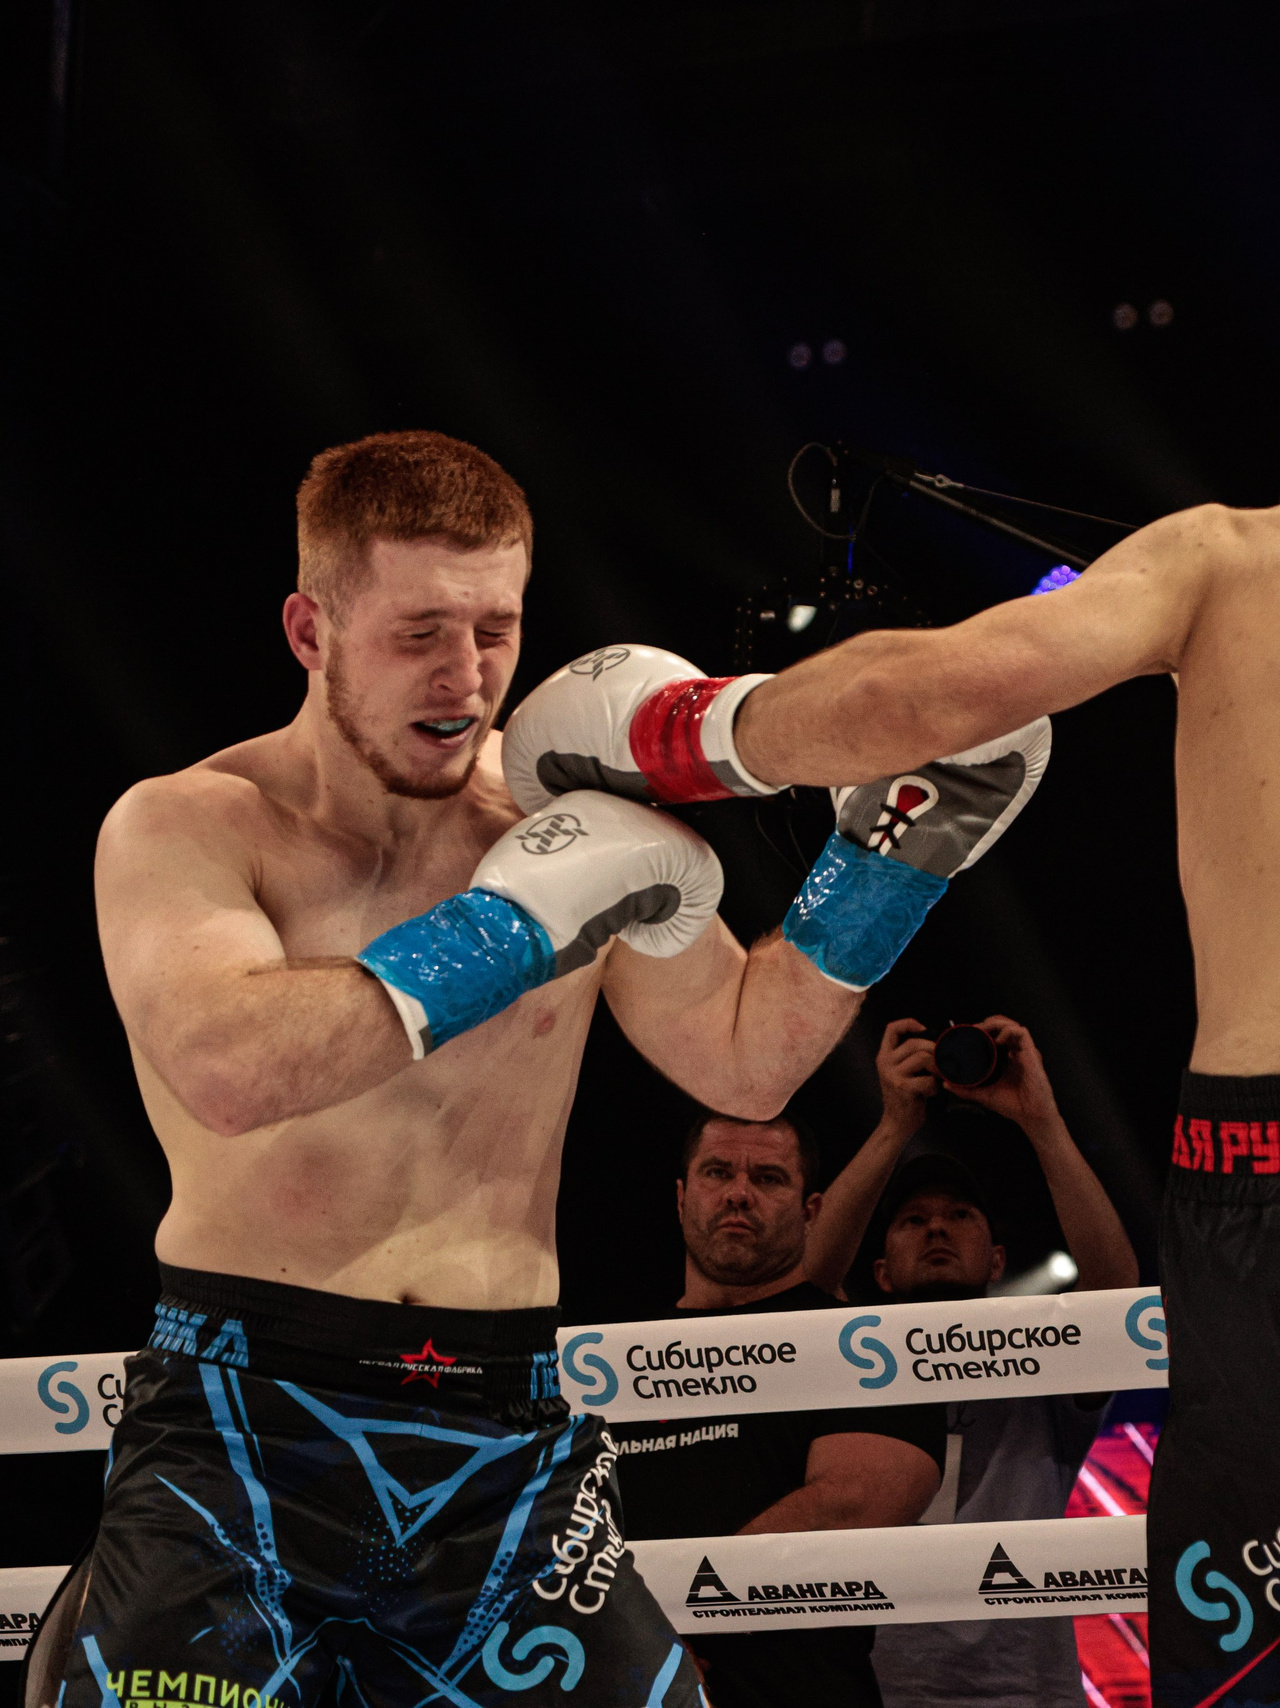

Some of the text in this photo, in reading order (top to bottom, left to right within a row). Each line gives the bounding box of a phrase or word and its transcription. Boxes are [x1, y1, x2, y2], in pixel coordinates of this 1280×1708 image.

[905, 1323, 1082, 1357] Сибирское
[626, 1340, 797, 1374] Сибирское
[912, 1356, 1041, 1382] Стекло
[632, 1374, 758, 1400] Стекло
[679, 1423, 739, 1447] НАЦИЯ
[1043, 1567, 1149, 1588] АВАНГА
[748, 1580, 888, 1601] АВАНГАРД
[983, 1593, 1103, 1606] СТРОИТЕЛЬНАЯ
[692, 1602, 896, 1619] СТРОИТЕЛЬНАЯ КОМПАНИЯ
